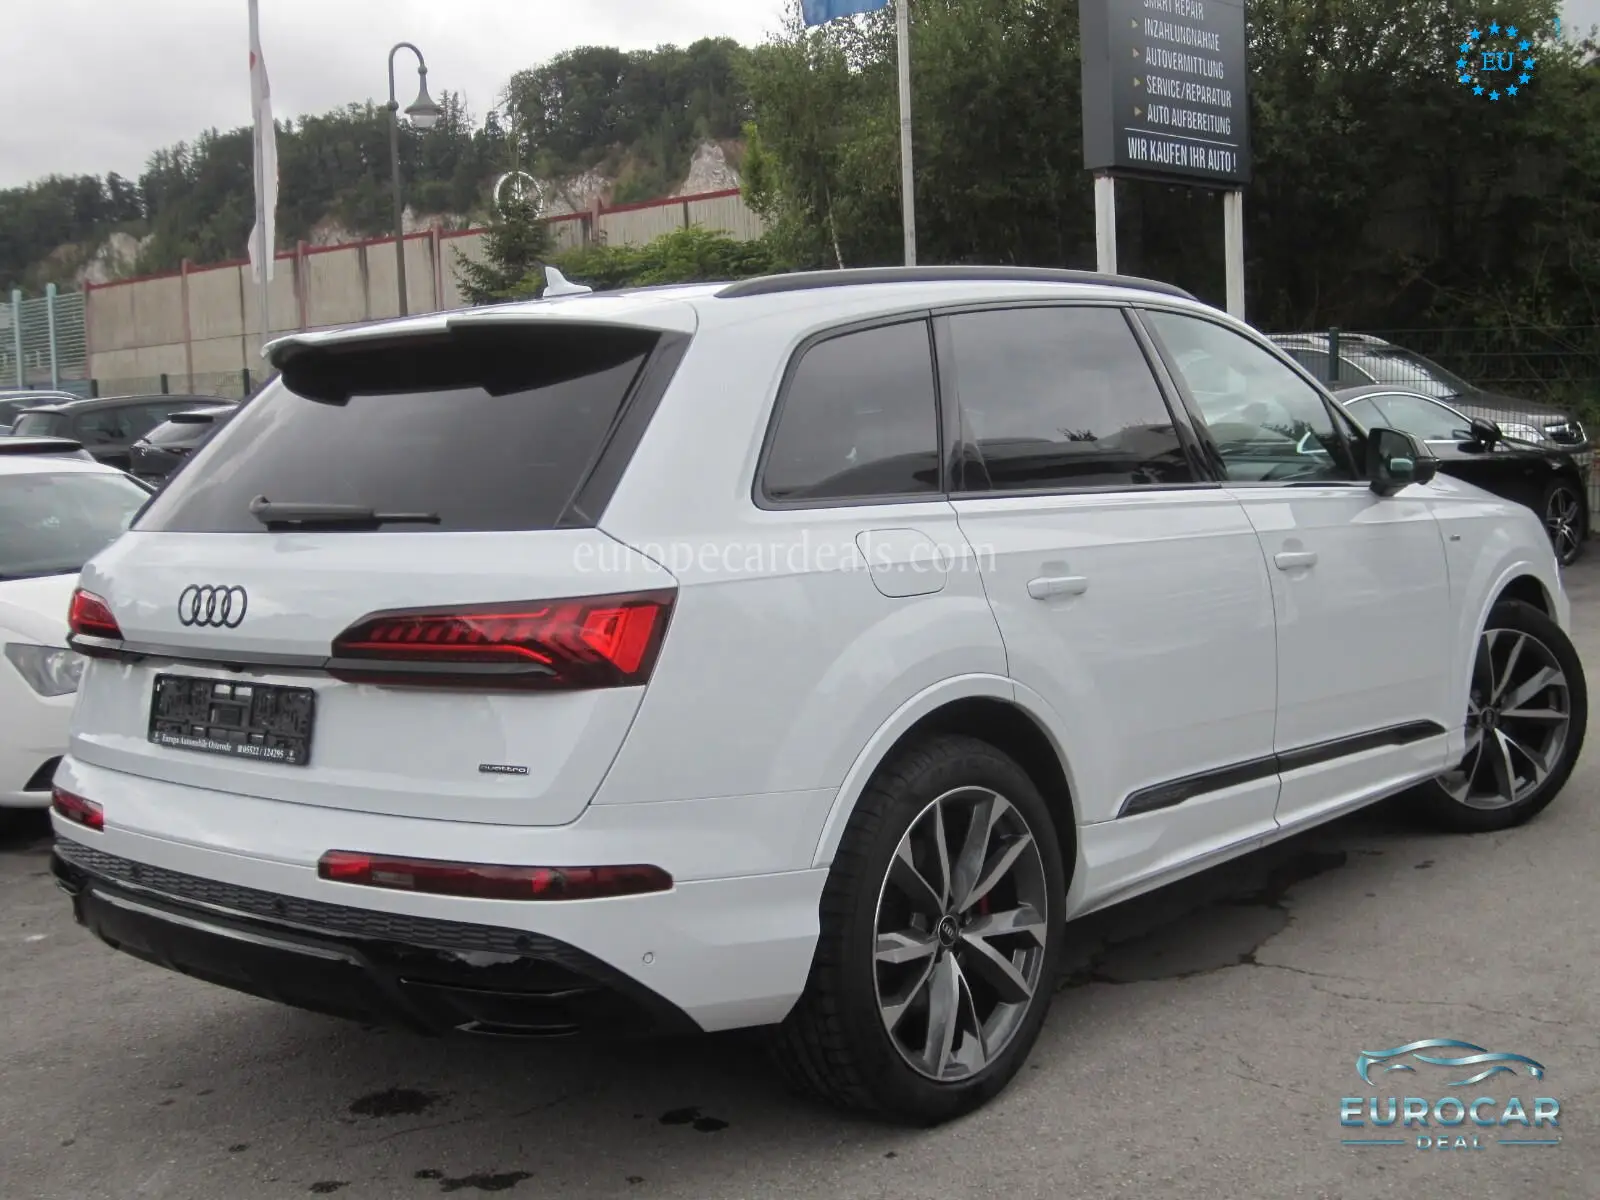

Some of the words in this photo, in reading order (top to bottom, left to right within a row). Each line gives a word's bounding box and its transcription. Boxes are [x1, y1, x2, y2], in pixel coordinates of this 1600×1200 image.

[1174, 0, 1204, 21] REPAIR
[1144, 17, 1221, 52] INZAHLUNGNAHME
[1145, 46, 1225, 80] AUTOVERMITTLUNG
[1146, 74, 1232, 108] SERVICE/REPARATUR
[1147, 103, 1170, 125] AUTO
[1171, 107, 1232, 136] AUFBEREITUNG
[1127, 136, 1149, 161] WIR
[1149, 140, 1188, 166] KAUFEN
[1189, 145, 1206, 169] IHR
[180, 736, 208, 749] Automobile
[208, 740, 232, 752] Osterode
